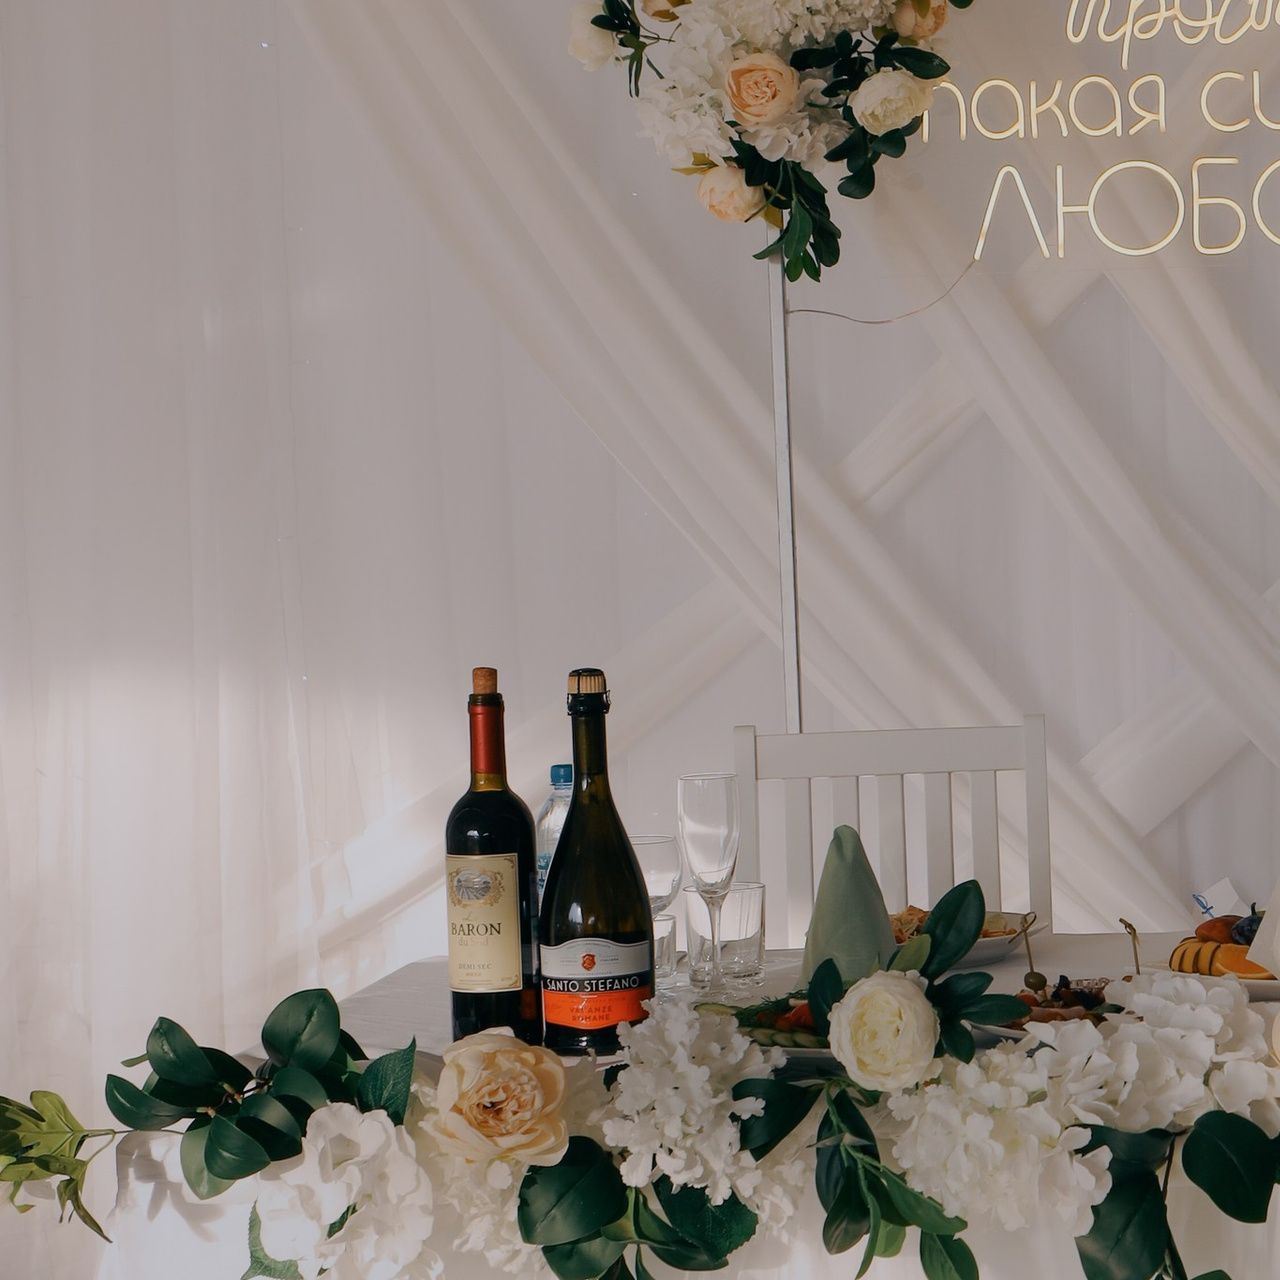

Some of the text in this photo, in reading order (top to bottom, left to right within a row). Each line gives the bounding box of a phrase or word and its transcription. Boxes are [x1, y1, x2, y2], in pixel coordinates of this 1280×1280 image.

[451, 923, 501, 936] BARON
[546, 976, 639, 992] SANTO STEFANO
